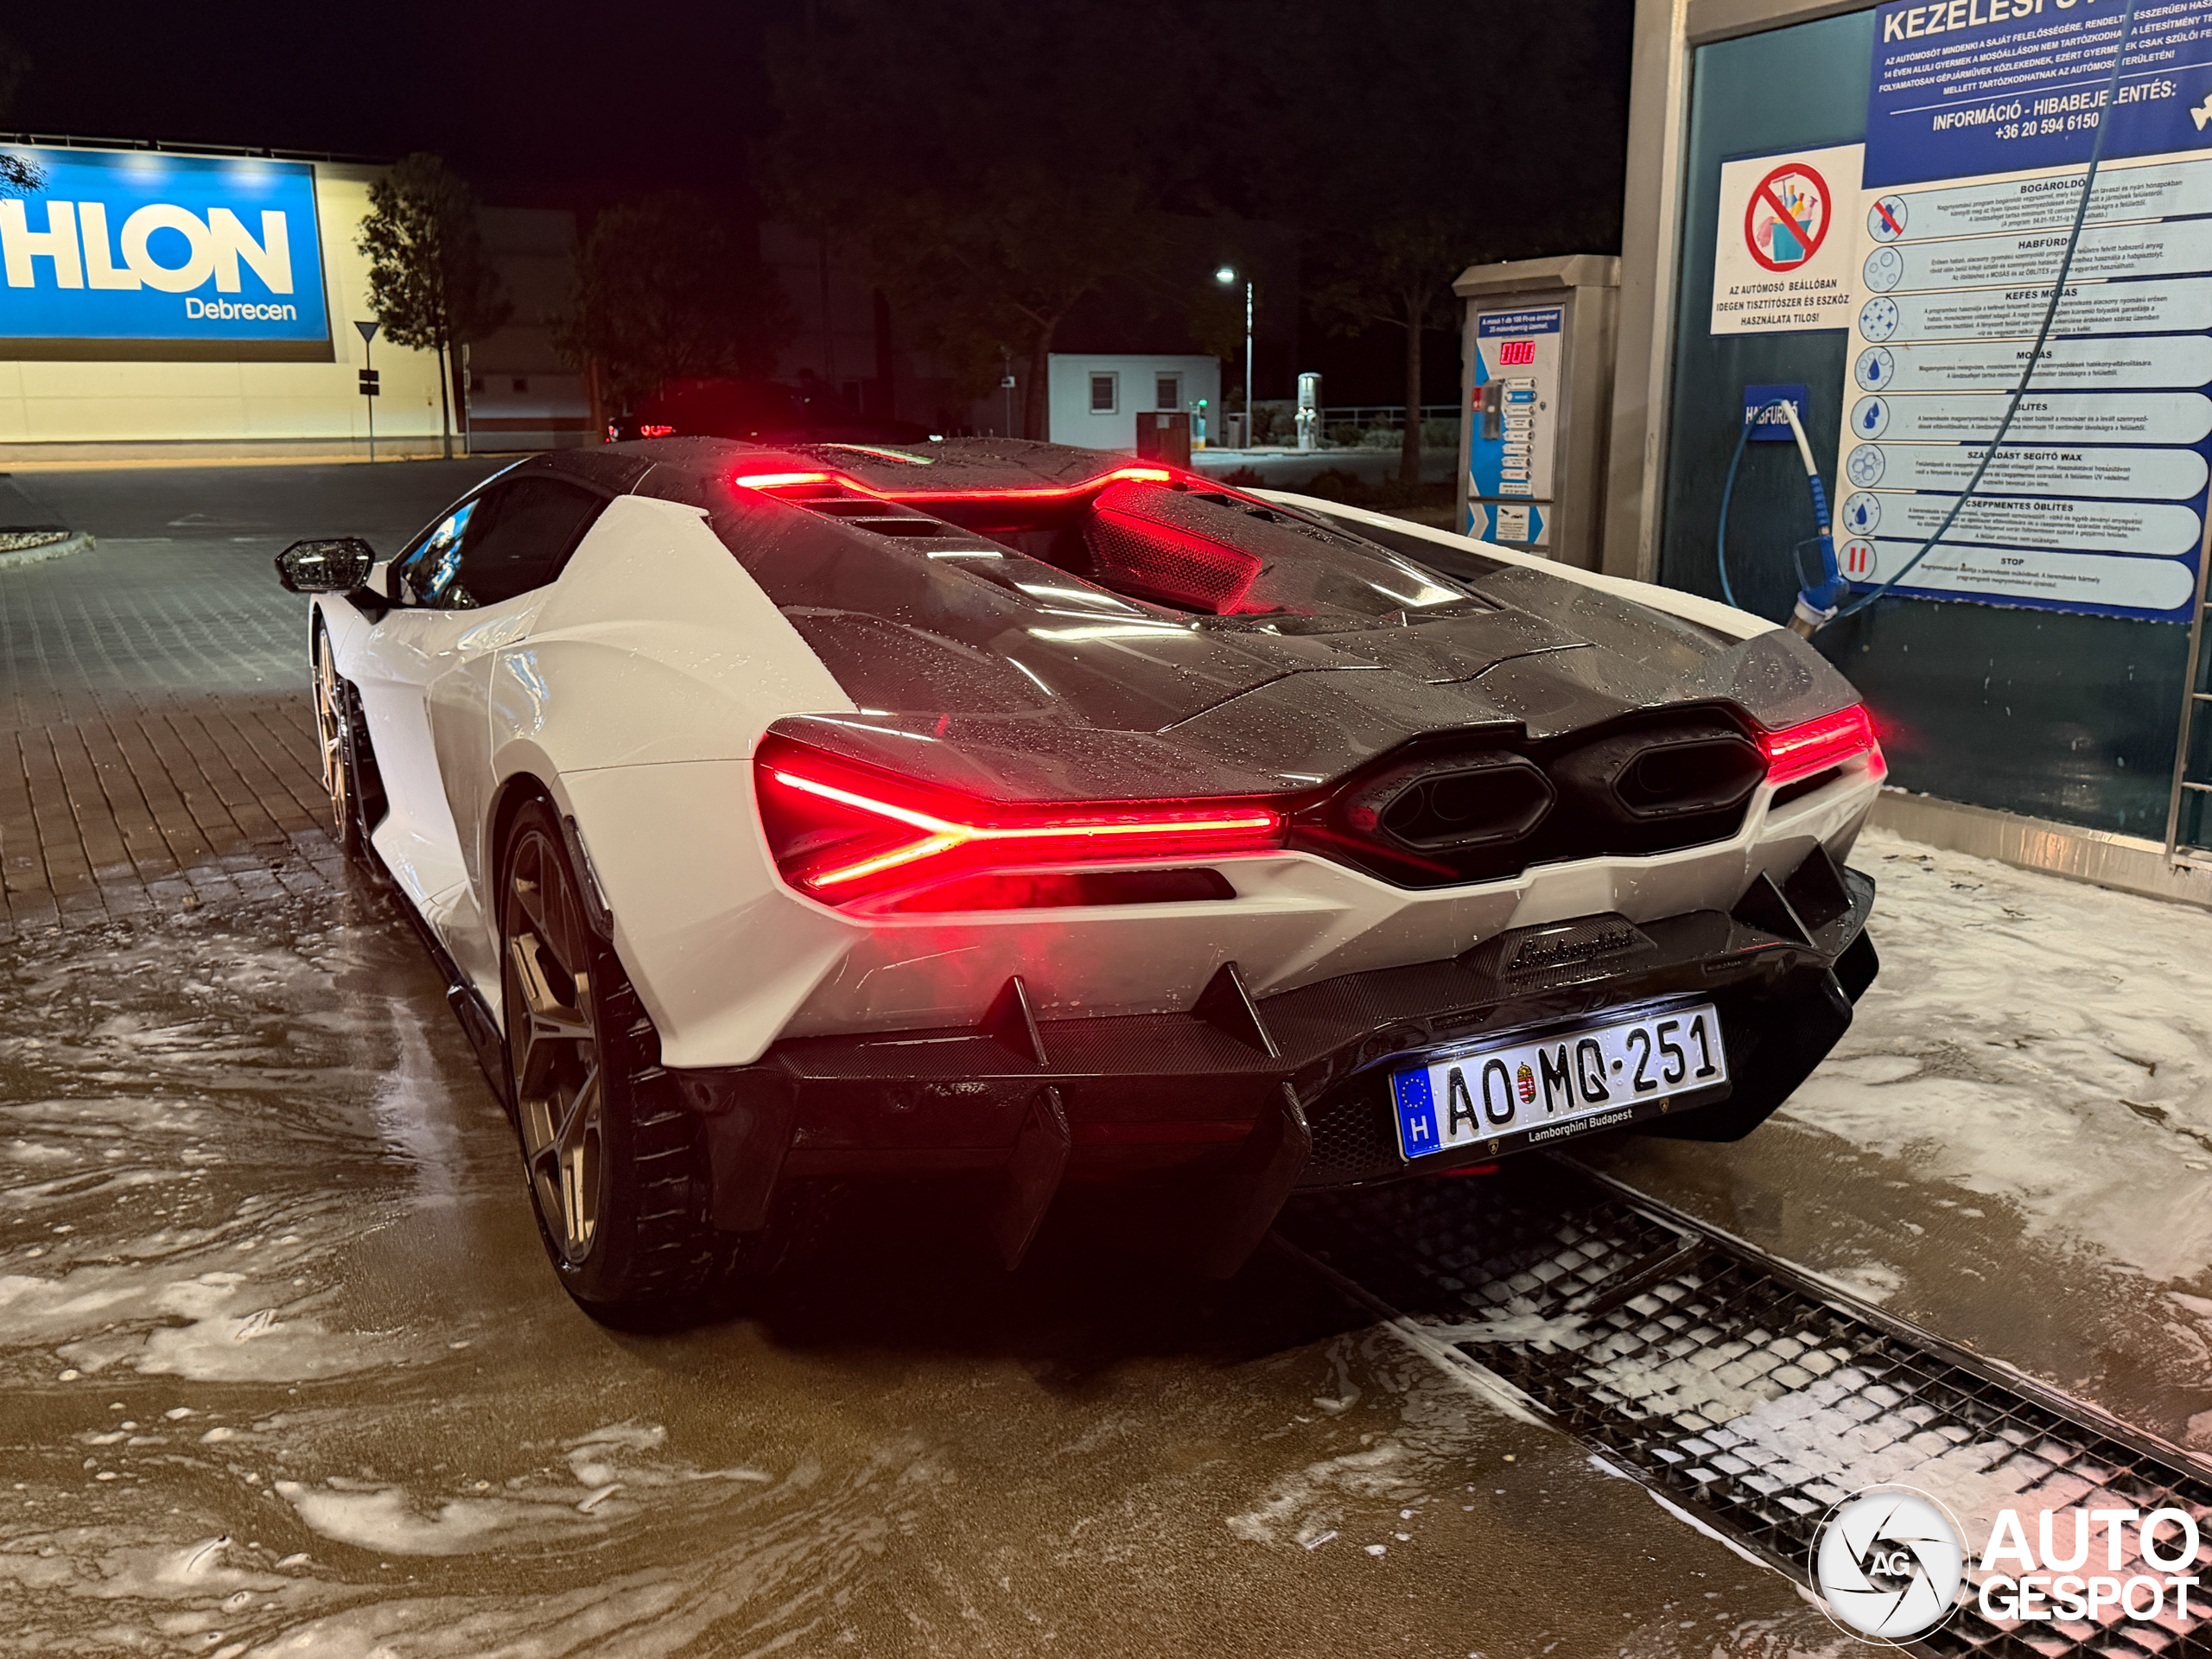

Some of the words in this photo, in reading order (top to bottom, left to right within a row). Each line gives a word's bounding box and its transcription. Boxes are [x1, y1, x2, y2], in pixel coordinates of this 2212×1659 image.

[1884, 68, 1891, 79] 14
[1892, 65, 1911, 77] ÉVEN
[1912, 61, 1934, 73] ALULI
[1935, 54, 1971, 69] GYERMEK
[1972, 54, 1978, 63] A
[2040, 39, 2059, 51] NEM
[2130, 25, 2138, 35] A
[1885, 55, 1895, 66] AZ
[1942, 40, 1978, 55] MINDENKI
[1979, 39, 1985, 48] A
[1986, 34, 2011, 48] SAJÁT
[1878, 74, 1935, 92] FOLYAMATOSAN
[2055, 49, 2082, 63] EZÉRT
[2082, 40, 2137, 58] GYERMEEK
[2139, 35, 2164, 48] CSAK
[1943, 80, 1977, 94] MELLETT
[1979, 67, 2056, 89] TARTÓZKODHATNAK
[2057, 66, 2069, 76] AZ
[1932, 99, 2022, 130] INFORMÁCIÓ
[2033, 75, 2177, 117] HIBABEJEENTÉS:
[1994, 122, 2018, 140] +36
[2021, 119, 2037, 137] 20
[2039, 116, 2063, 134] 594
[2067, 111, 2099, 130] 6150
[2018, 236, 2070, 249] HABFÜRD
[1730, 286, 1739, 296] AZ
[1741, 281, 1784, 294] AUTÓMOSÓ
[1789, 278, 1837, 291] BEÁLLÓBAN
[2005, 289, 2037, 300] KEFÉS
[185, 297, 297, 321] Debrecen
[1716, 302, 1744, 312] IDEGEN
[1804, 296, 1815, 306] ÉS
[1740, 314, 1791, 326] HASZNÁLATA
[1794, 313, 1820, 323] TILOS!
[2016, 350, 2052, 359] MOÁS
[2060, 452, 2082, 461] WAX
[1965, 499, 2031, 510] CSEPPMENTES
[2000, 557, 2024, 566] STOP
[1448, 1058, 1516, 1136] AO
[1410, 1115, 1430, 1142] H
[1529, 1120, 1587, 1143] Lamborghini
[1589, 1109, 1633, 1131] Budapest
